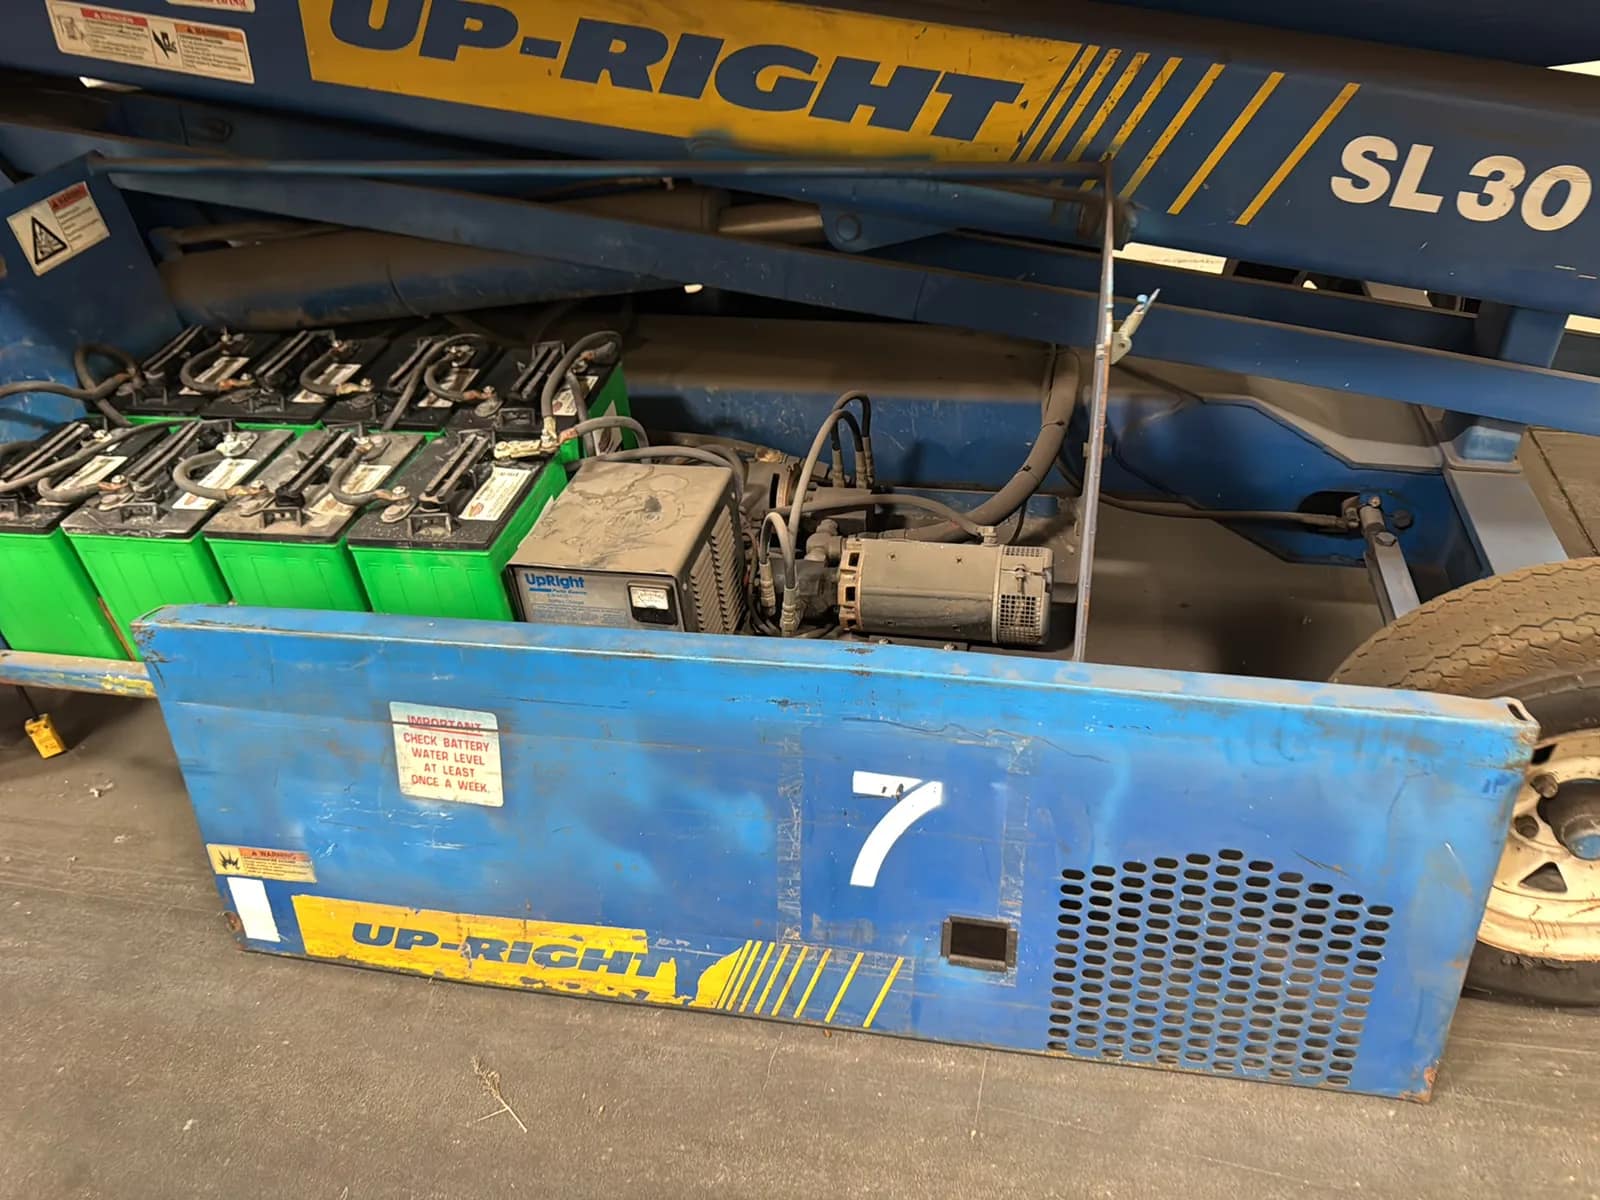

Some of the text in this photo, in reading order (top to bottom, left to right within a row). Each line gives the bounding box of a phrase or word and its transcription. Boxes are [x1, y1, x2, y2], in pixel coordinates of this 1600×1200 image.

[329, 0, 1025, 142] UP-RIGHT
[1331, 135, 1593, 232] SL 30
[524, 573, 585, 589] UpRight
[407, 715, 482, 732] IMPORTANT
[403, 732, 490, 753] CHECK BATTERY
[411, 747, 486, 766] WATER LEVEL
[424, 763, 475, 778] AT LEAST
[411, 774, 440, 787] ONCE
[444, 779, 453, 789] A
[850, 770, 944, 888] 7
[352, 922, 673, 979] UP-RIGHT
